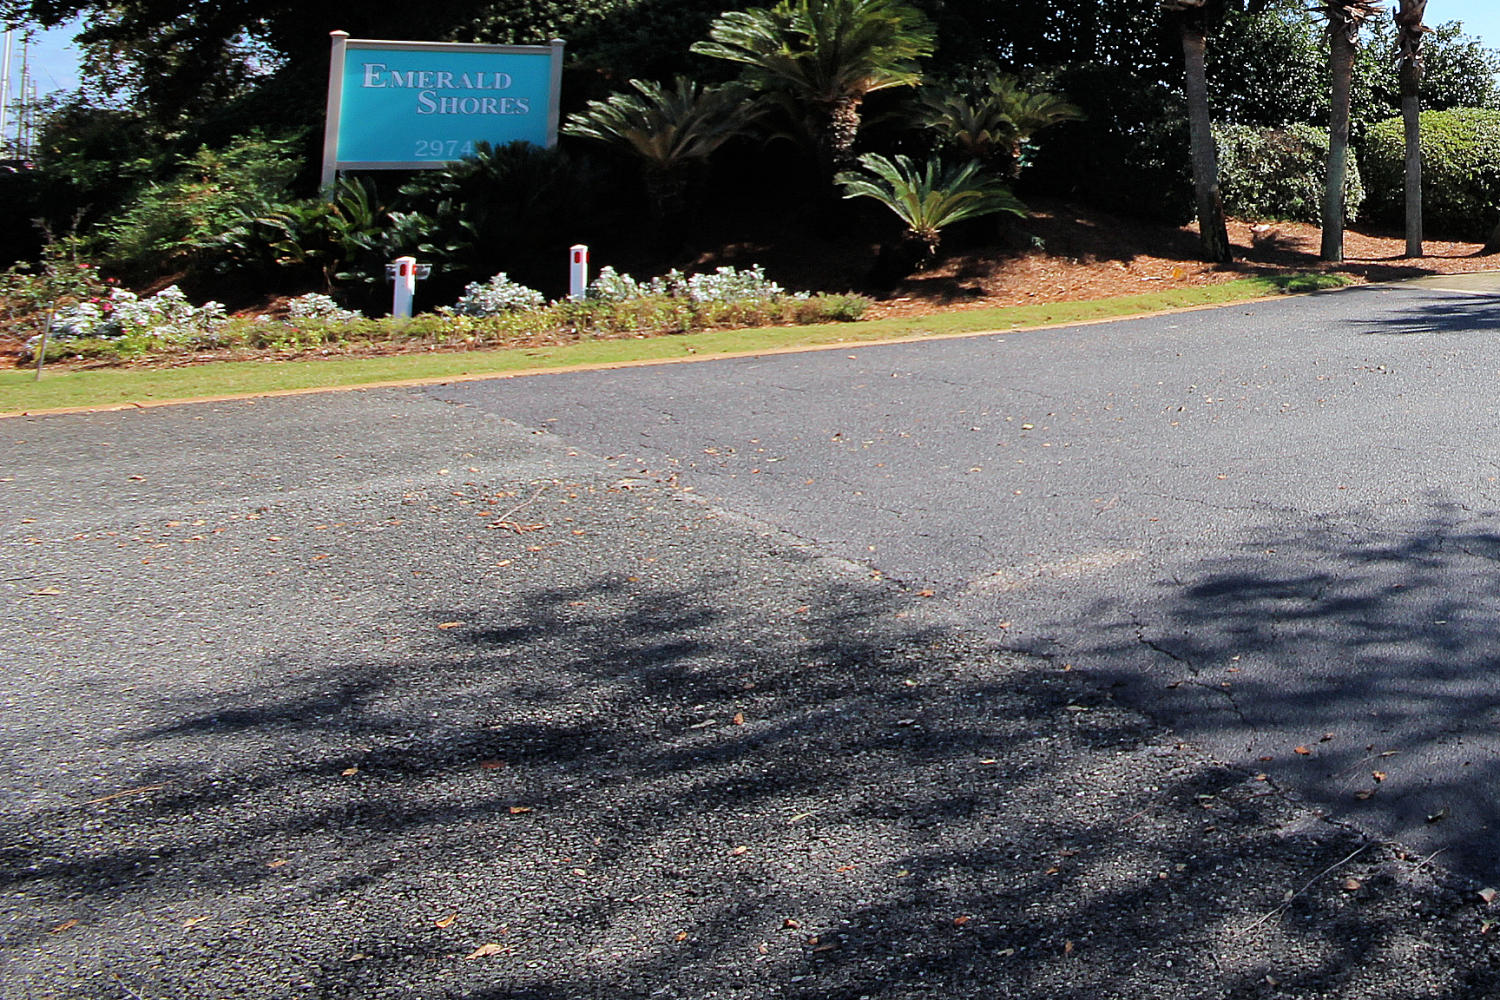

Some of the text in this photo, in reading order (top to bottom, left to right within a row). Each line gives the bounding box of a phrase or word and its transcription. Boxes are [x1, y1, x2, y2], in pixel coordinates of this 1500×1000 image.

[362, 62, 512, 90] EMERALD
[416, 90, 530, 115] SHORES
[414, 139, 473, 157] 2974
